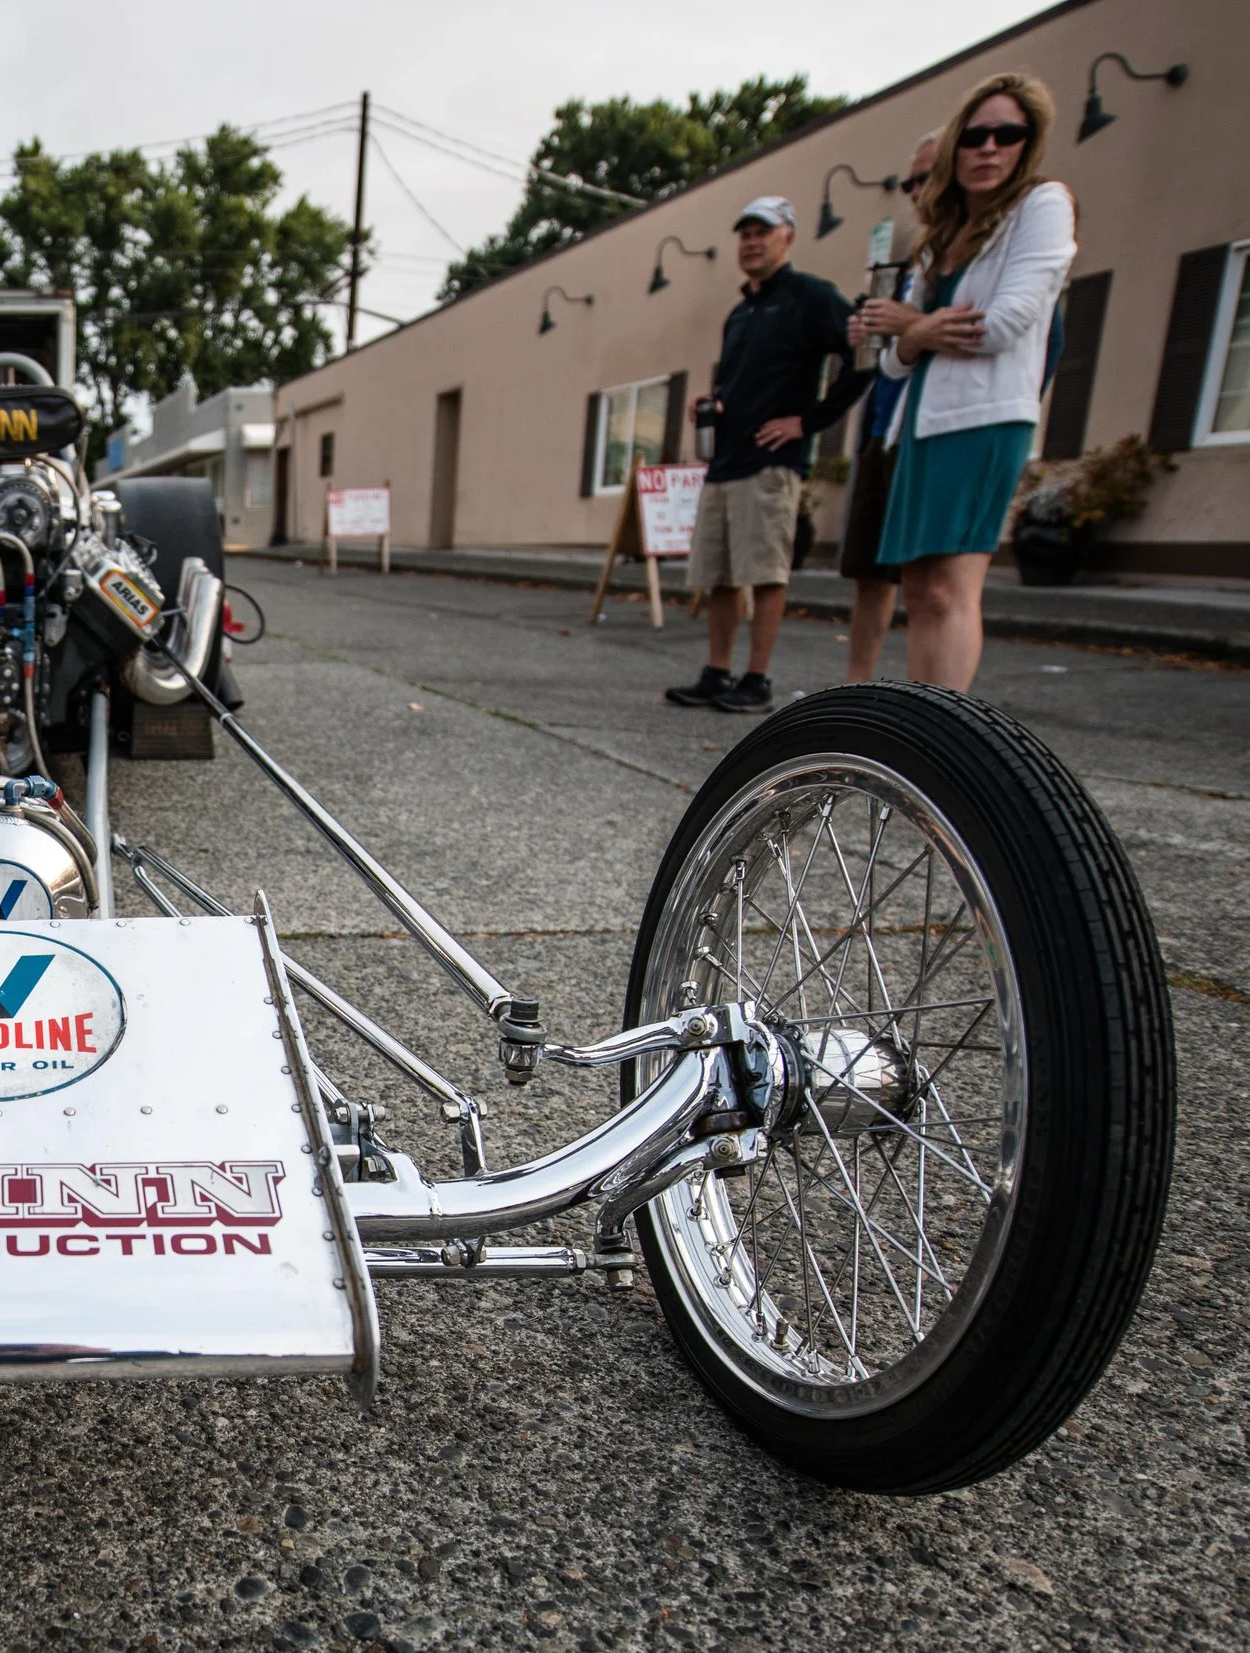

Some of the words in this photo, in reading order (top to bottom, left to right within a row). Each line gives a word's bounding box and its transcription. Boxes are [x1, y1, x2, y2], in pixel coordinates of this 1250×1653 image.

[638, 468, 664, 490] NO
[111, 581, 149, 615] ARIAS
[32, 1060, 74, 1070] OIL
